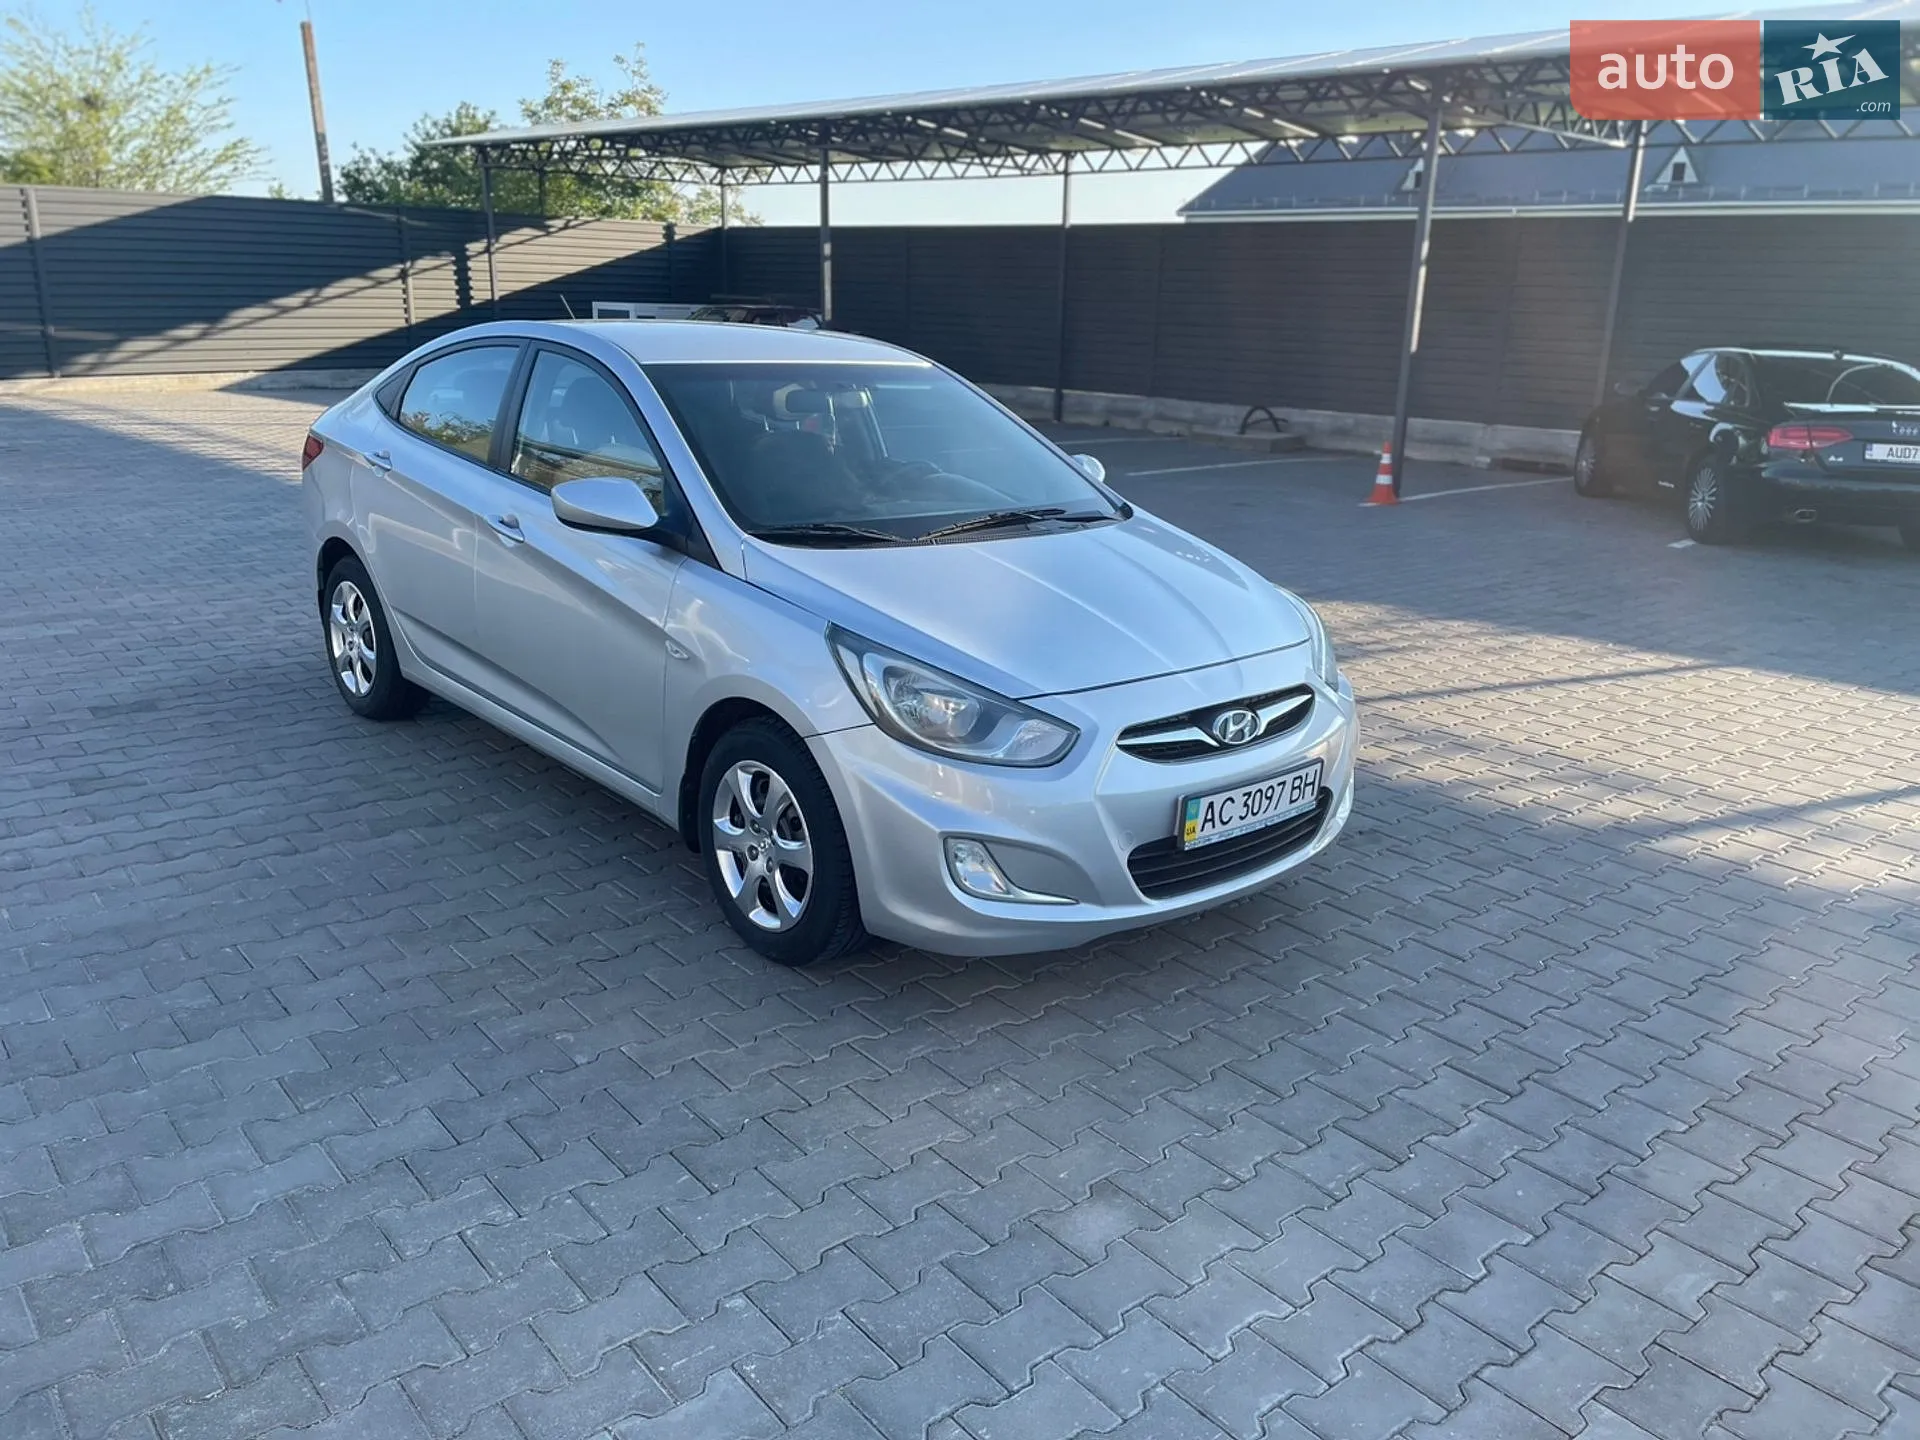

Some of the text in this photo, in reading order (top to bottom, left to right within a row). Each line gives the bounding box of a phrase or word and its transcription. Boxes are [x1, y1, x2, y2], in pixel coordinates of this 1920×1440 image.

[1200, 797, 1235, 832] AC
[1239, 780, 1287, 821] 3097
[1289, 769, 1318, 804] BH
